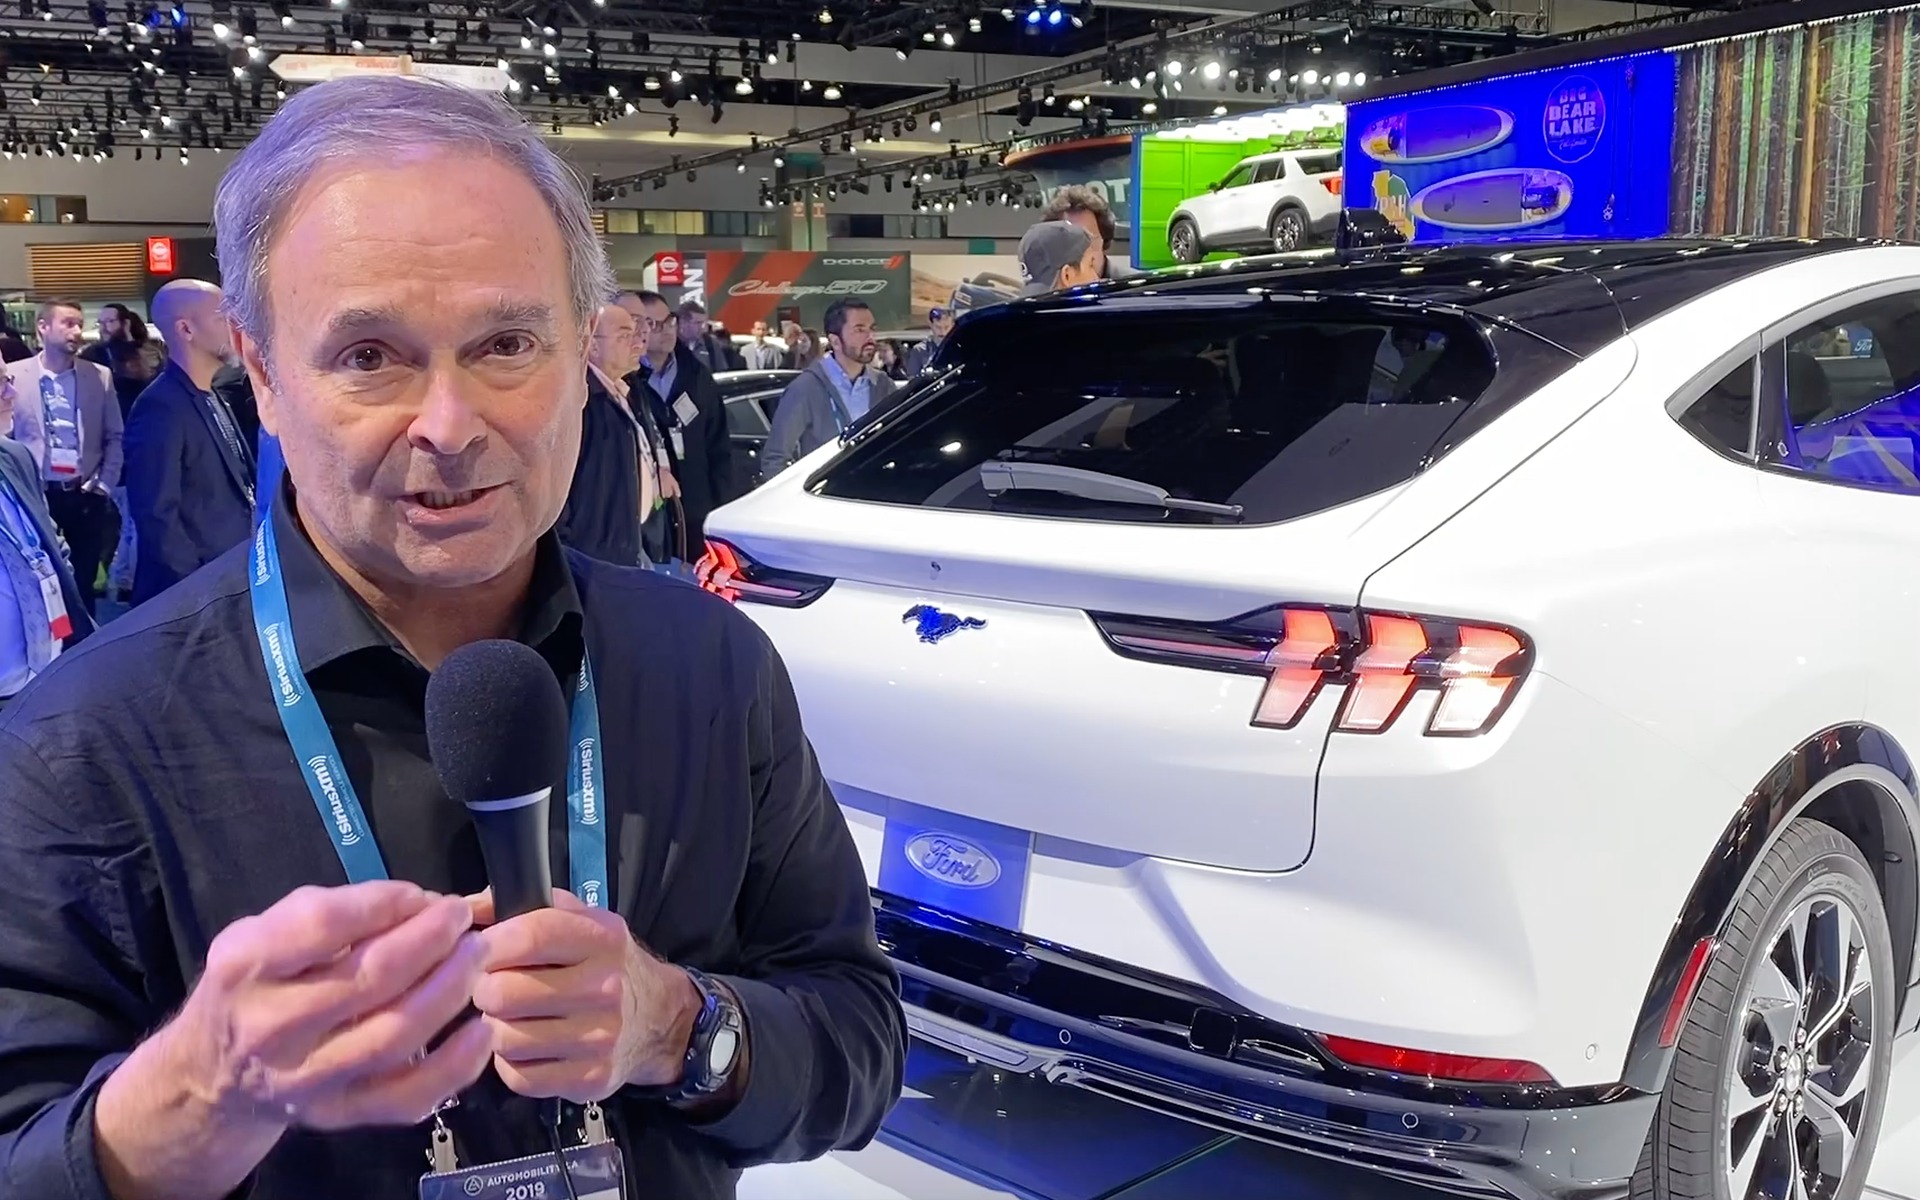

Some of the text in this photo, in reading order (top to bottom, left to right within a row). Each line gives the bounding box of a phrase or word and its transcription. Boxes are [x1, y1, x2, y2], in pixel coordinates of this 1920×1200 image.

[1560, 86, 1587, 103] BIG
[1548, 101, 1596, 121] BEAR
[1548, 116, 1596, 137] LAKE
[822, 258, 893, 266] DODGE
[922, 839, 982, 882] Ford
[505, 1182, 546, 1200] 2019
